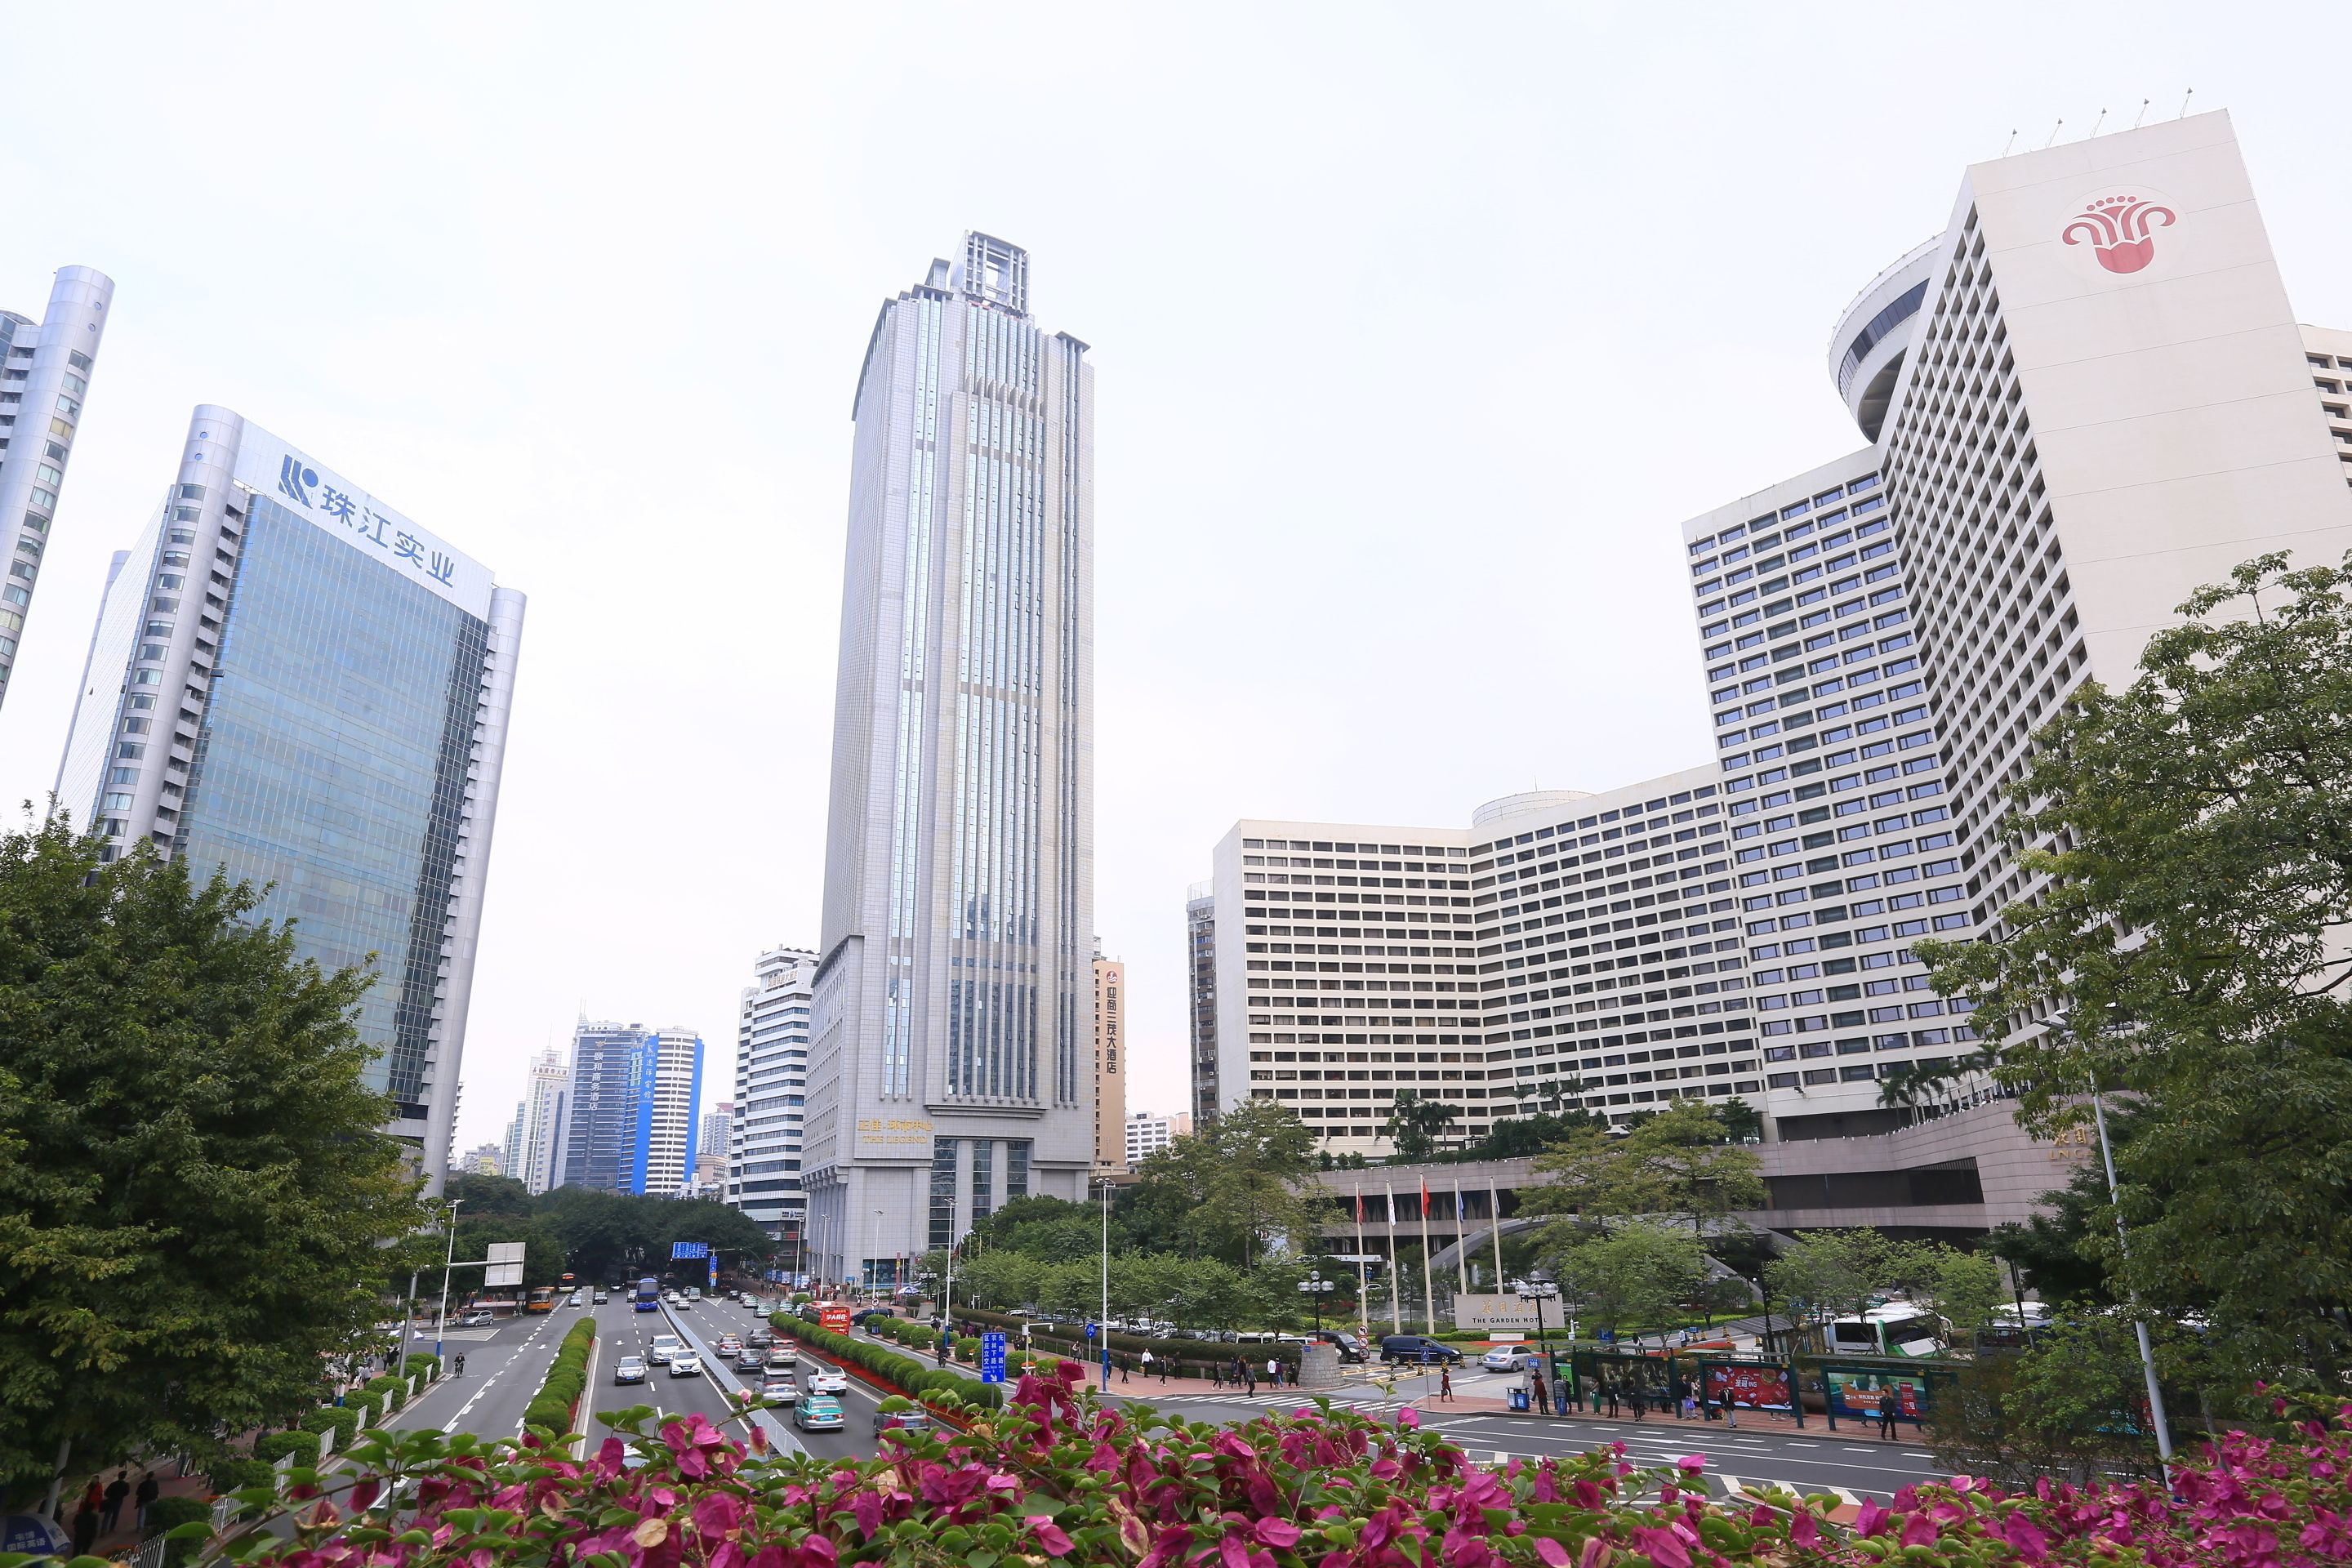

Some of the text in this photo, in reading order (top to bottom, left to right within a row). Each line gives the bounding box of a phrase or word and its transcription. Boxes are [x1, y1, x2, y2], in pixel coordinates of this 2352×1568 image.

[320, 483, 455, 588] 珠江实业
[1106, 987, 1117, 1074] 迎商三茂大酒店
[589, 1052, 604, 1111] 颐和商务酒店
[863, 1135, 928, 1144] THE LEGEND
[7, 1537, 47, 1552] 国际英语
